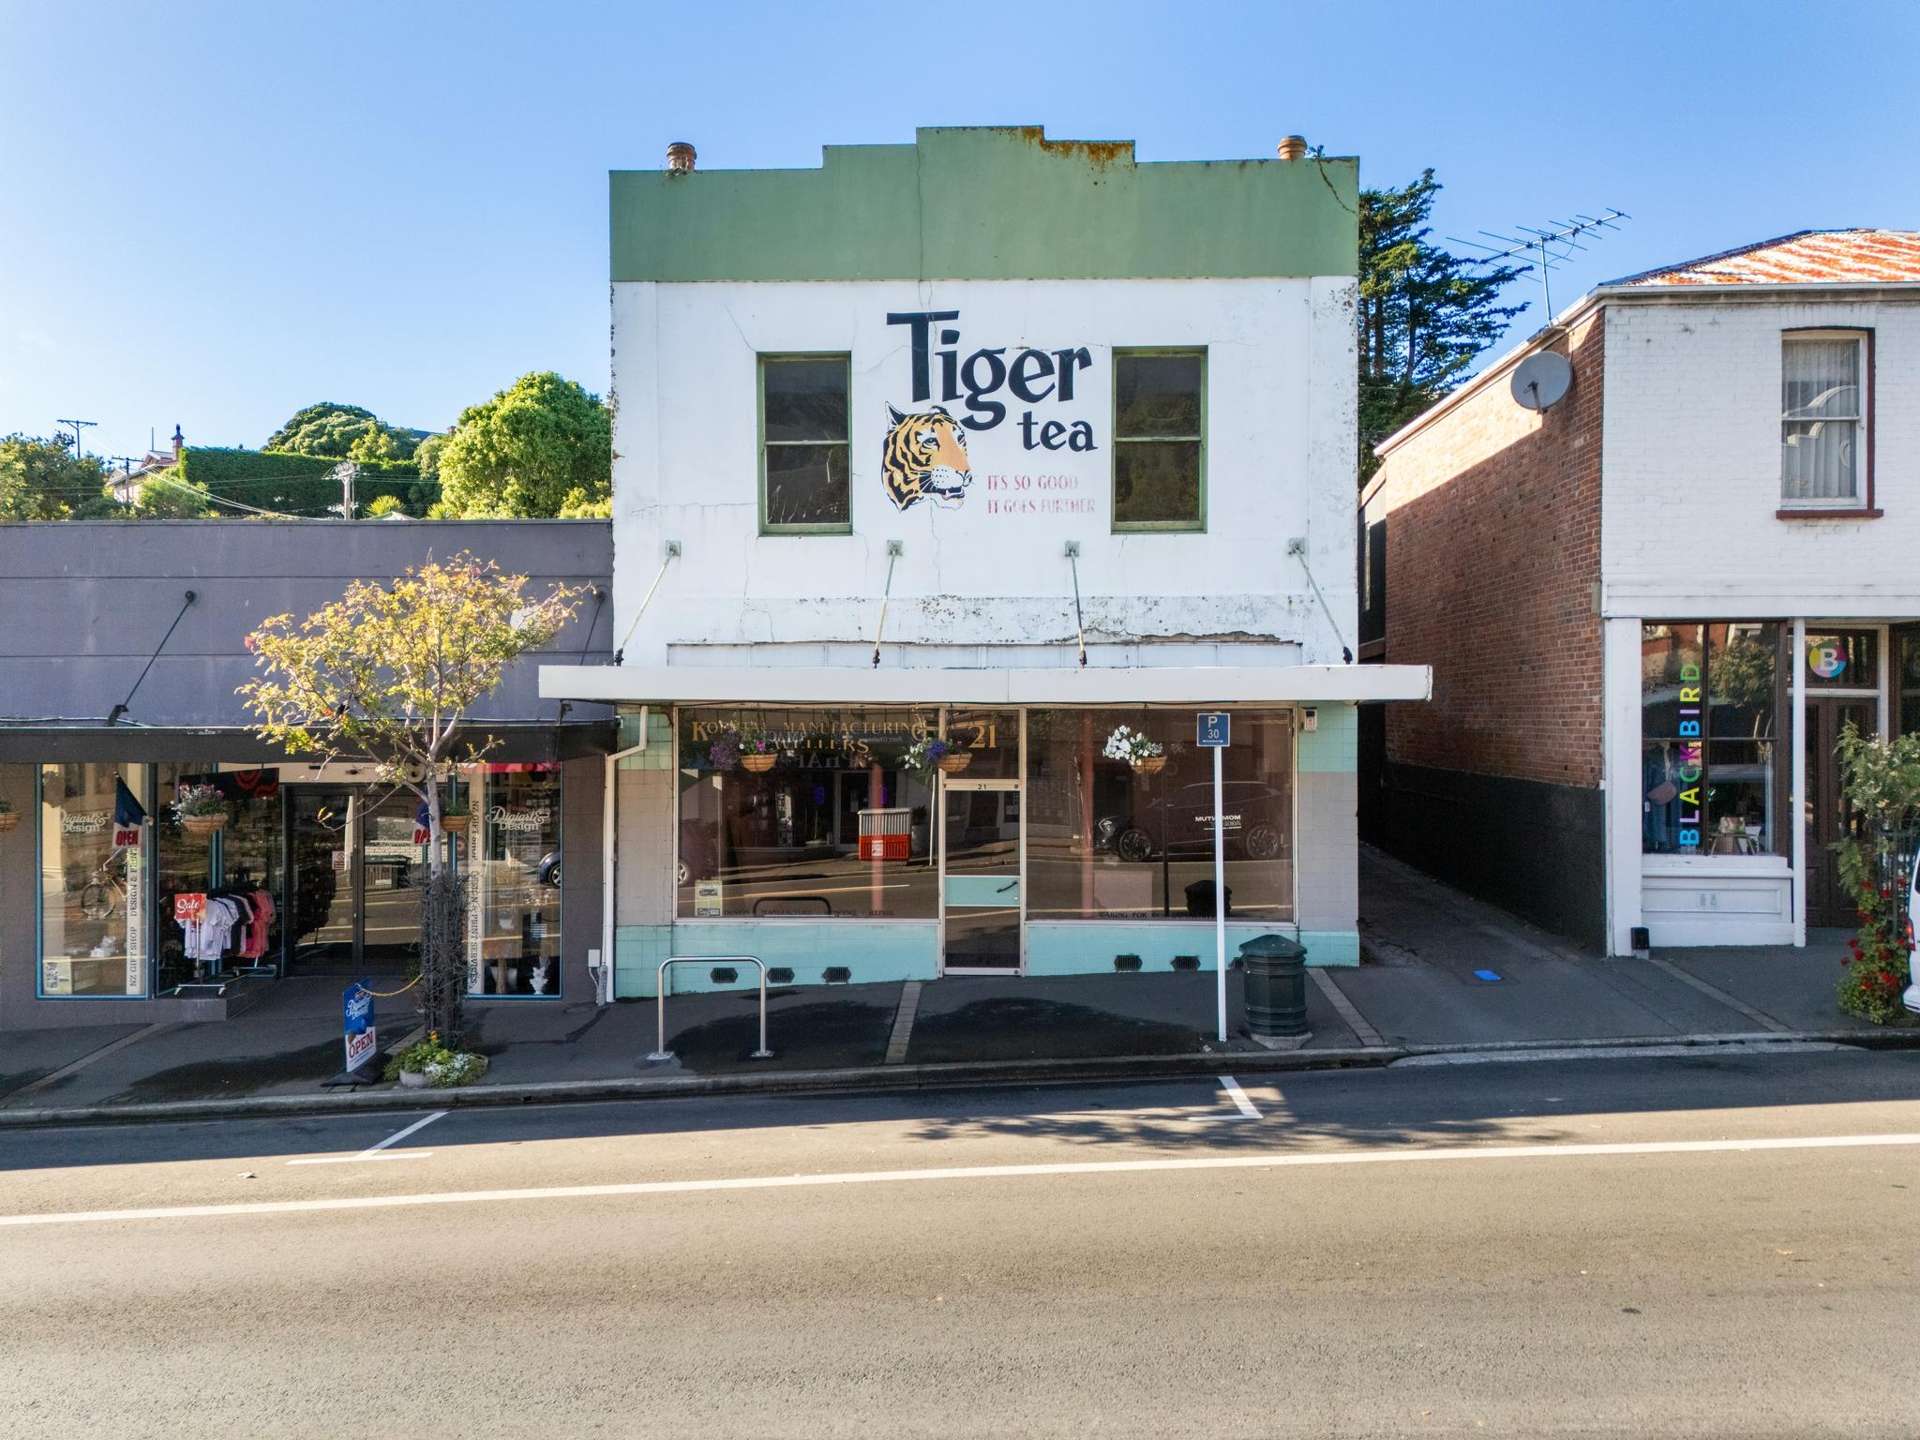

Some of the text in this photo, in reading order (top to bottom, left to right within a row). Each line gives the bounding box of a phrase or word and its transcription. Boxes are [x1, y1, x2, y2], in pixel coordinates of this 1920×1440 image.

[887, 310, 1092, 431] Tiger
[1016, 411, 1099, 452] tea
[1013, 474, 1032, 490] SO
[1037, 474, 1079, 490] GOOD
[1819, 648, 1839, 671] B
[783, 718, 927, 743] MANUFACTURING
[1207, 716, 1218, 728] P
[968, 724, 997, 749] 21
[1207, 729, 1220, 739] 30
[1680, 662, 1700, 848] BLACKBIRD
[115, 829, 139, 847] OPEN
[498, 822, 539, 832] Design
[176, 898, 200, 914] Sale
[349, 1031, 374, 1059] OPEN
